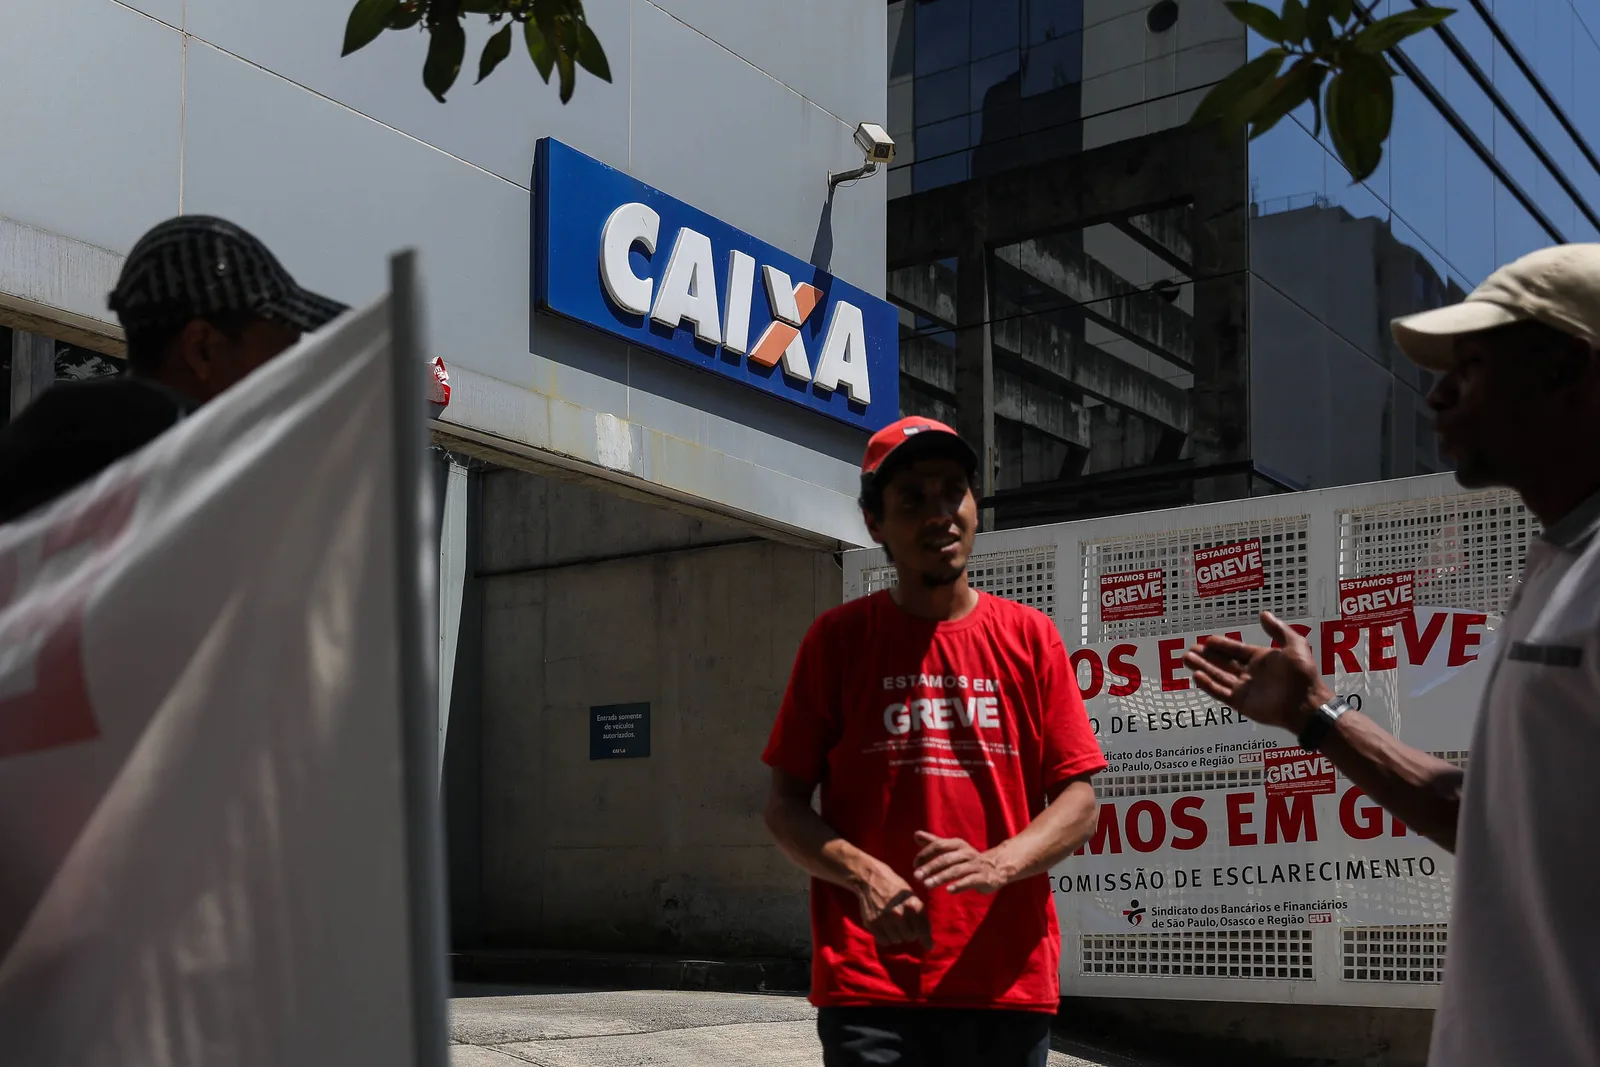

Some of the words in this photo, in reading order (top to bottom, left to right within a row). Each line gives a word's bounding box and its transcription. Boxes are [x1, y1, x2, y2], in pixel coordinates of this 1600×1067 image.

[600, 202, 872, 406] CAIXA
[1195, 546, 1242, 561] ESTAMOS
[1244, 542, 1259, 552] EM
[1196, 551, 1262, 584] GREVE
[1101, 573, 1145, 585] ESTAMOS
[1147, 571, 1161, 579] EM
[1340, 576, 1394, 591] ESTAMOS
[1396, 573, 1412, 582] EM
[1101, 580, 1163, 608] GREVE
[1341, 583, 1413, 615] GREVE
[883, 673, 969, 690] ESTAMOS
[973, 678, 1000, 692] EM
[597, 713, 617, 721] Entrada
[883, 696, 1000, 735] GREVE
[1111, 715, 1138, 734] DE
[1135, 749, 1153, 759] dos
[1155, 745, 1204, 758] Bancários
[1206, 746, 1212, 754] e
[1215, 739, 1278, 754] Financiários
[1122, 762, 1152, 773] Paulo,
[1154, 760, 1188, 770] Osasco
[1191, 759, 1197, 767] e
[1200, 755, 1234, 768] Região
[1266, 757, 1335, 783] GREVE
[1226, 792, 1318, 847] EM
[1175, 869, 1202, 888] DE
[1213, 856, 1436, 886] ESCLARECIMENTO
[1151, 905, 1198, 917] Sindicato
[1200, 904, 1219, 915] dos
[1221, 902, 1272, 914] Bancários
[1274, 903, 1280, 912] e
[1283, 899, 1348, 912] Financiários
[1152, 918, 1164, 929] de
[1166, 917, 1185, 928] São
[1187, 916, 1218, 928] Paulo,
[1220, 916, 1254, 927] Osasco
[1258, 917, 1265, 926] e
[1267, 913, 1305, 927] Região
